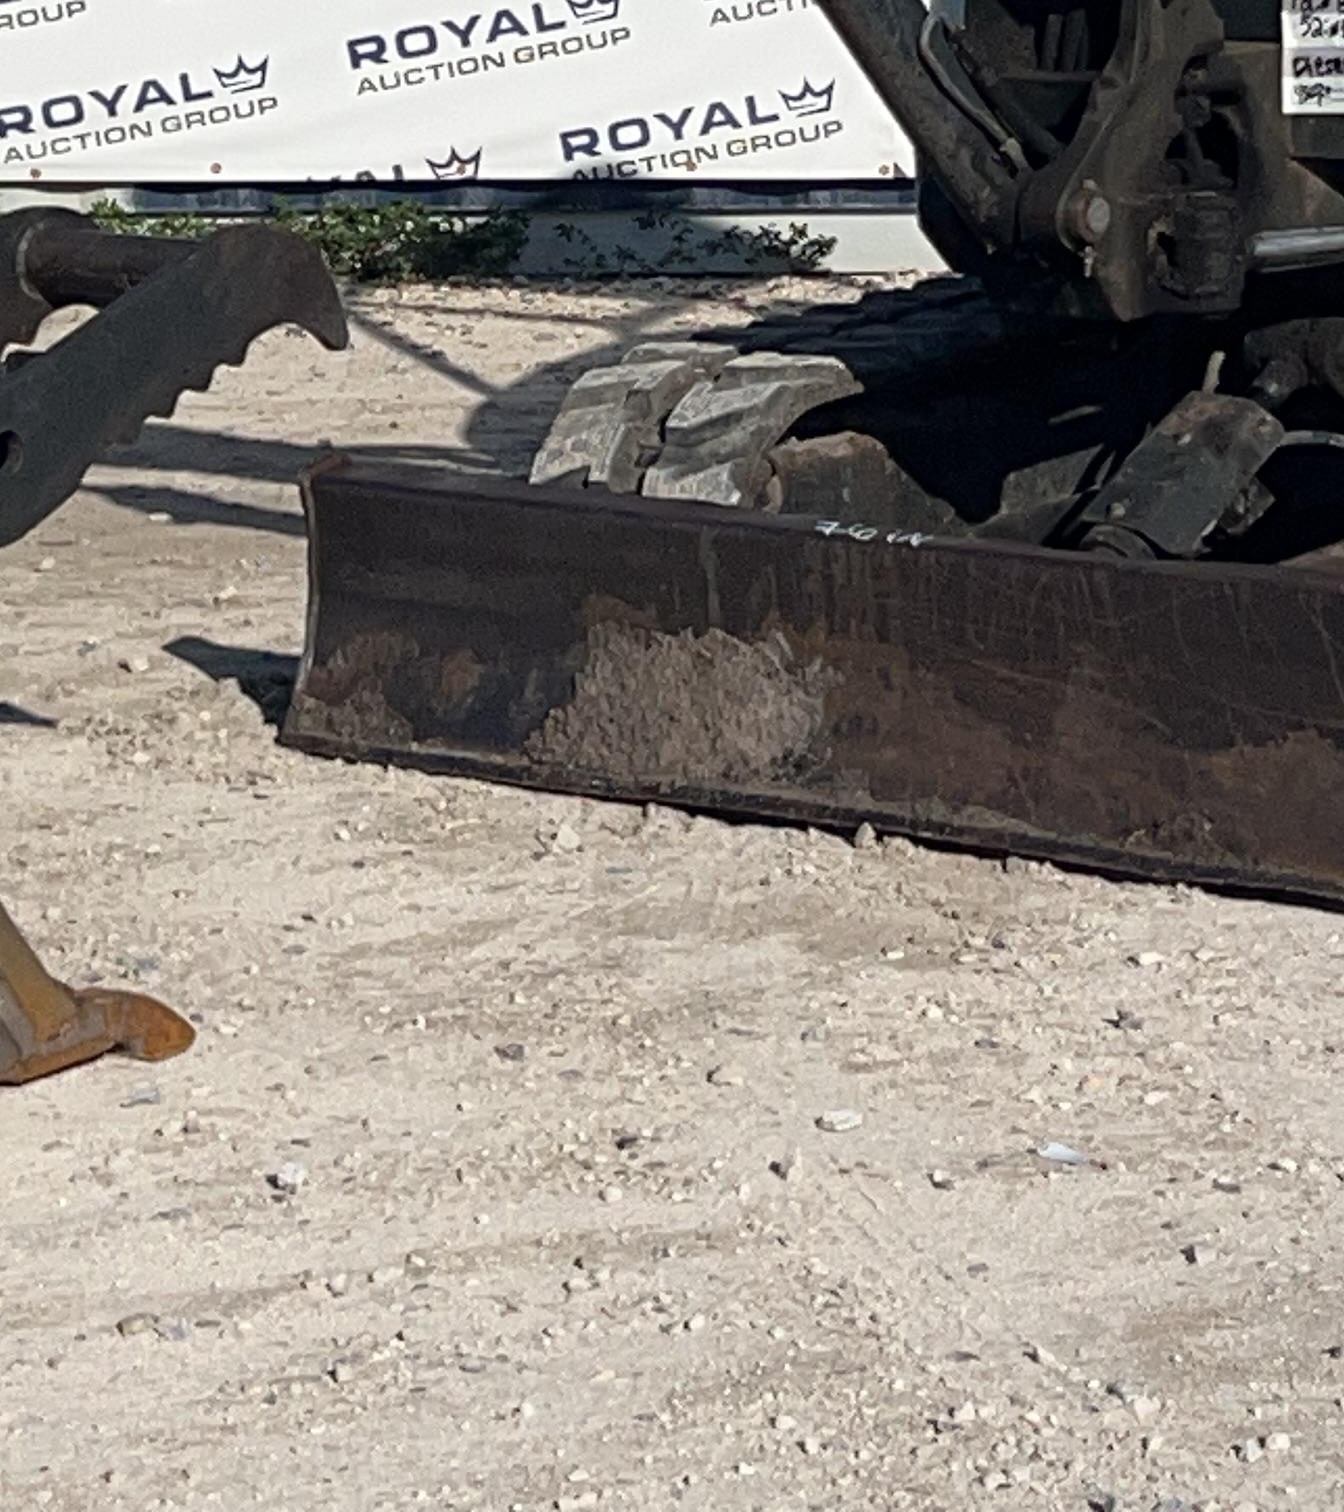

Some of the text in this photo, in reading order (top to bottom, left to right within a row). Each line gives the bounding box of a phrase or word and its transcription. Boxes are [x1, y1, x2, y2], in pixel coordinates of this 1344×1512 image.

[345, 2, 568, 71] ROYAL
[357, 26, 631, 96] AUCTION GROUP
[3, 96, 279, 165] AUCTION GROUP
[558, 95, 781, 163] ROYAL
[725, 119, 844, 158] GROUP
